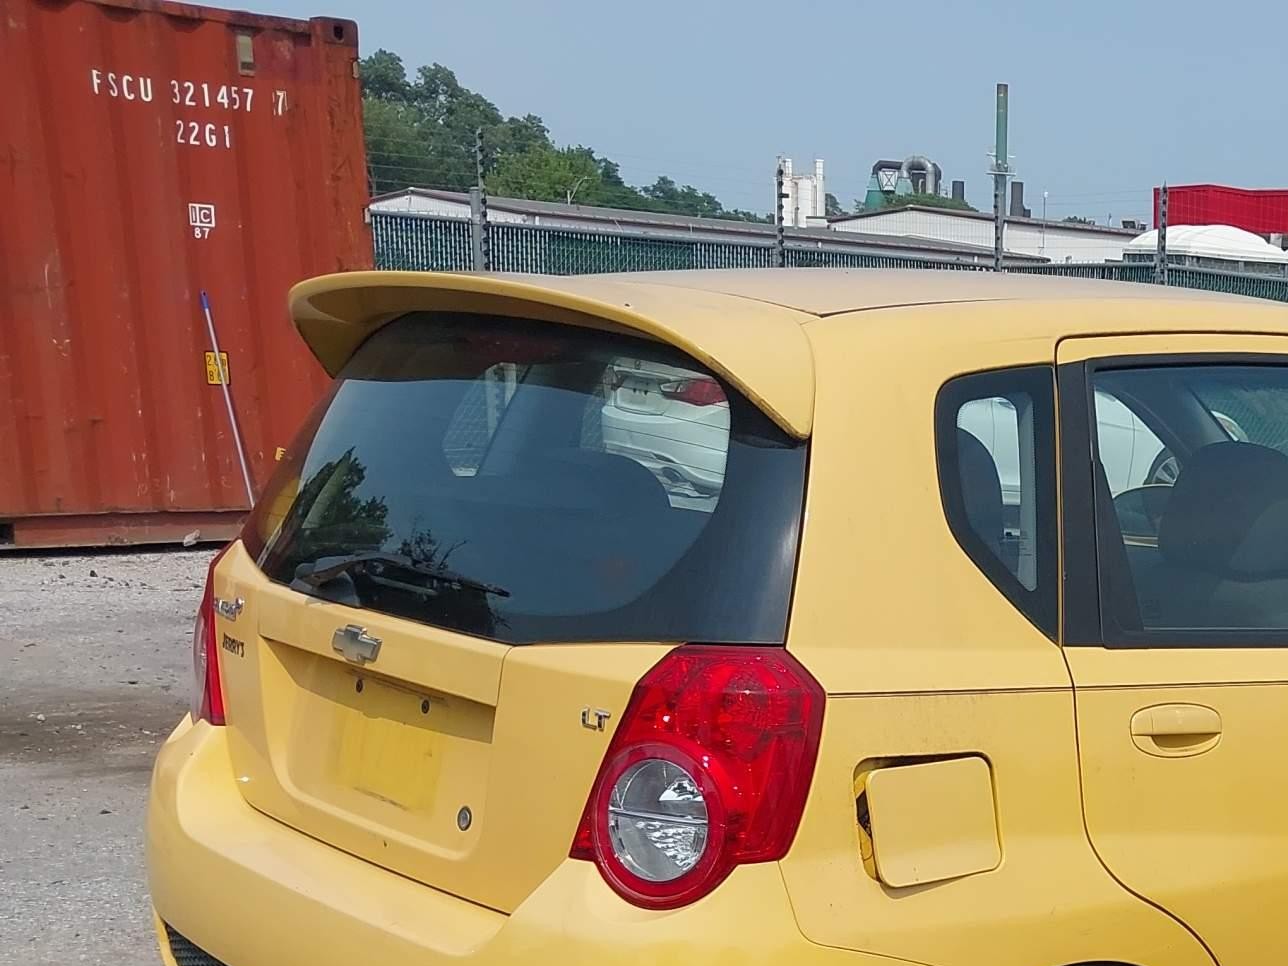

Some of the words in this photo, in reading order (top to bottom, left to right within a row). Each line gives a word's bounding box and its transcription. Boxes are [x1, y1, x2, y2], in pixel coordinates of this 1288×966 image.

[92, 69, 153, 102] FSCU
[171, 80, 253, 112] 321457
[273, 90, 287, 116] 7
[176, 120, 231, 149] 22G1
[194, 227, 210, 239] 87
[582, 708, 611, 732] LT
